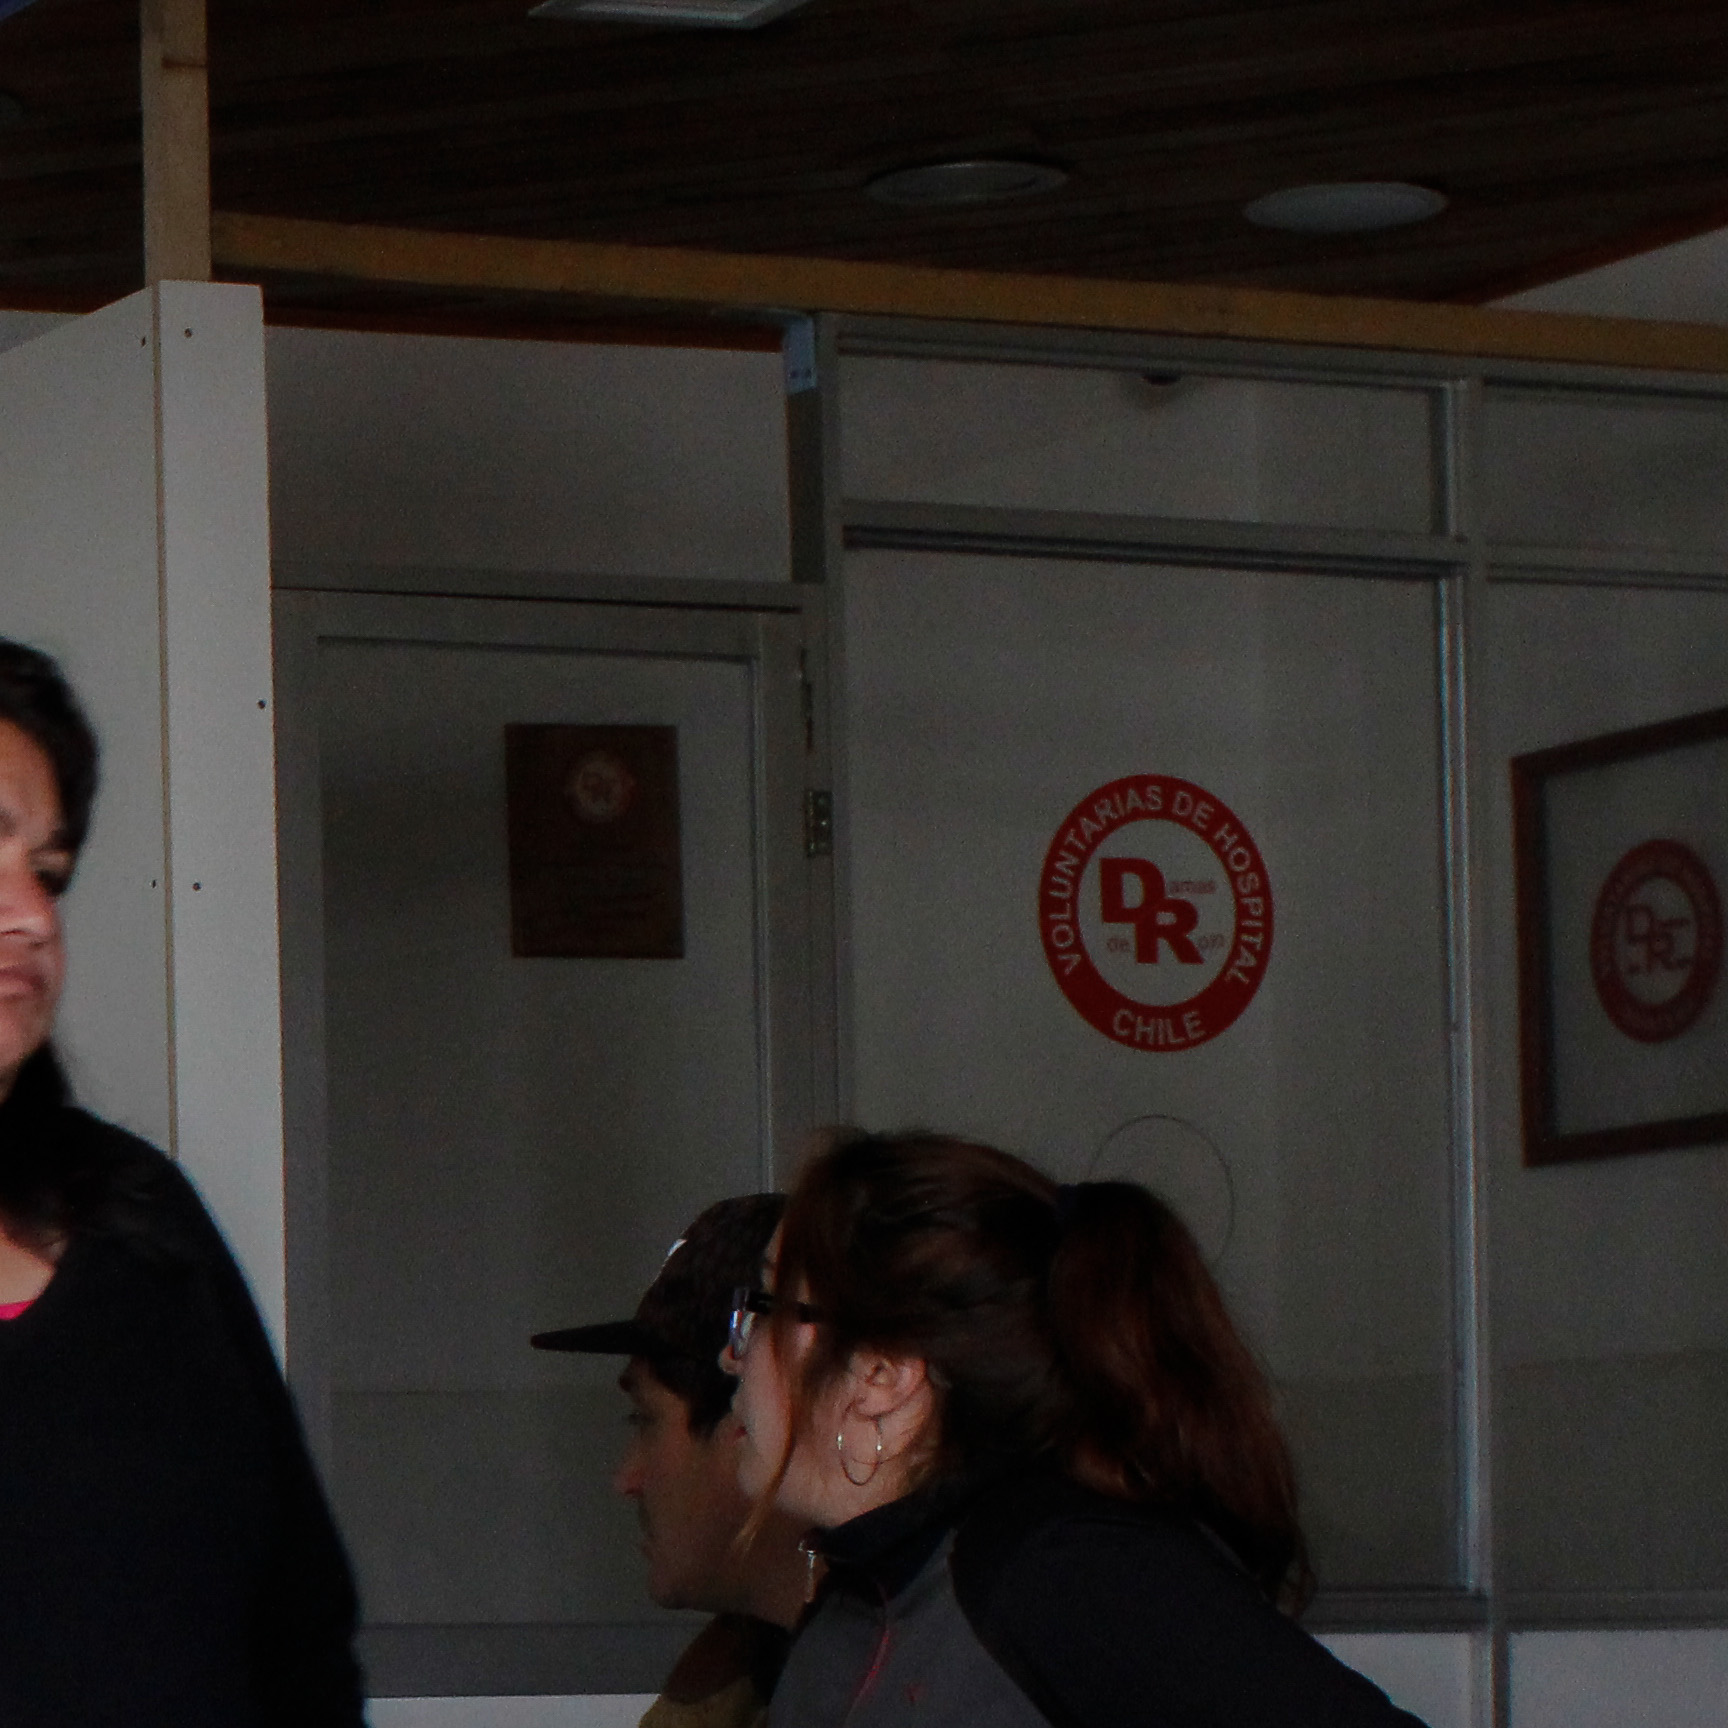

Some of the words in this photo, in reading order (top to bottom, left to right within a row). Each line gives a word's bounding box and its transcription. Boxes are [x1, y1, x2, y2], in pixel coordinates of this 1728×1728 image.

[1048, 784, 1164, 977] VOLUNTARIAS
[1170, 790, 1216, 829] DE
[1213, 822, 1268, 986] HOSPITAL
[1112, 1008, 1207, 1045] CHILE
